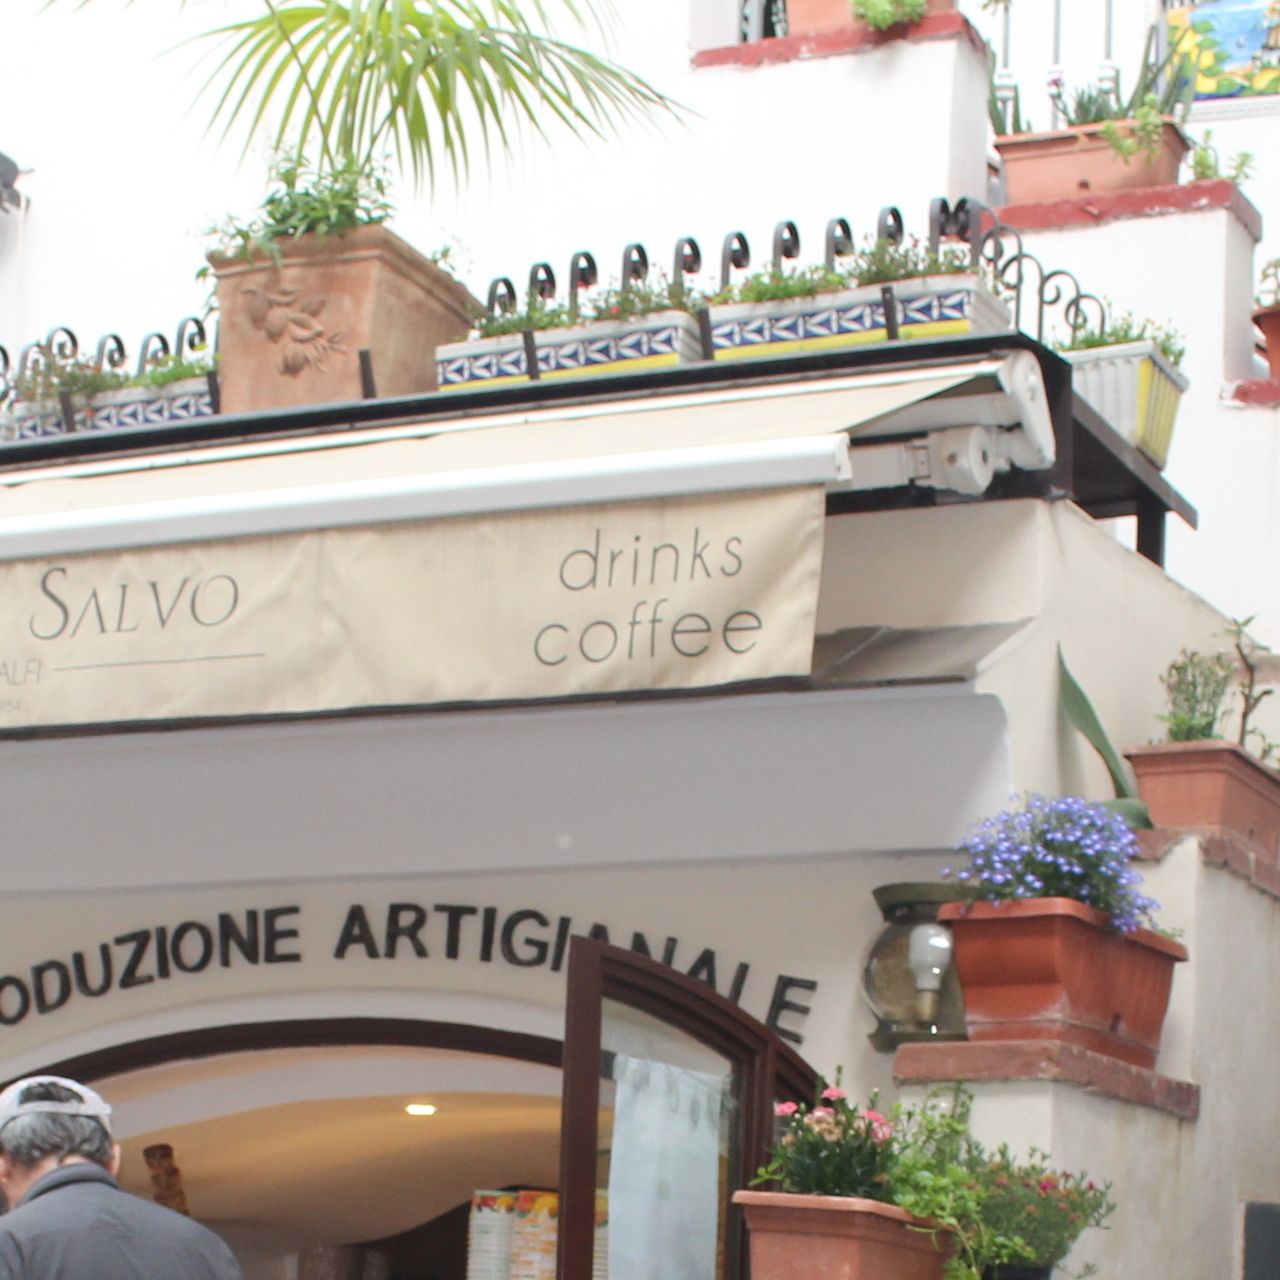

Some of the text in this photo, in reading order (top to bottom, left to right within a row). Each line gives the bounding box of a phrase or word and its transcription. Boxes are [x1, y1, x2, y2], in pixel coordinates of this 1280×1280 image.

[558, 525, 743, 592] drinks
[29, 567, 240, 642] SALVO
[533, 597, 763, 667] coffee
